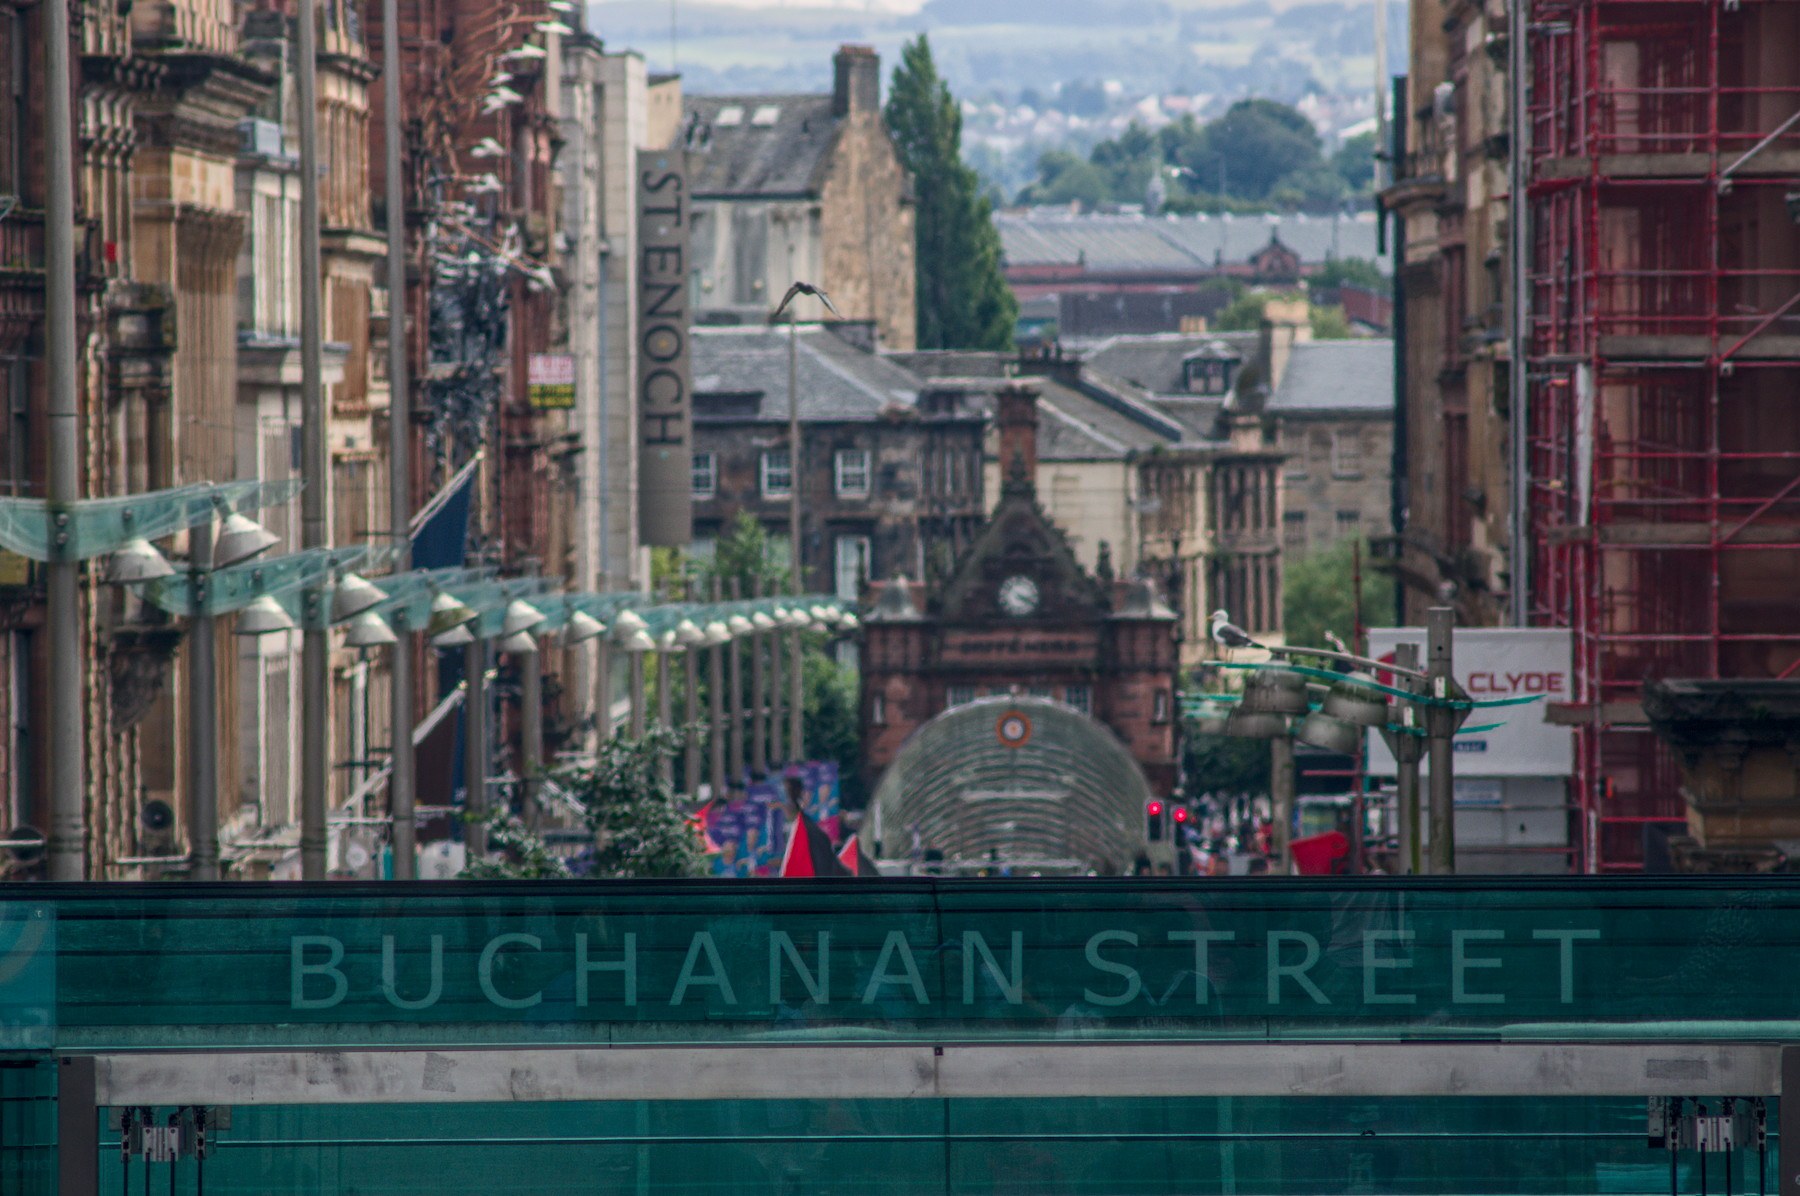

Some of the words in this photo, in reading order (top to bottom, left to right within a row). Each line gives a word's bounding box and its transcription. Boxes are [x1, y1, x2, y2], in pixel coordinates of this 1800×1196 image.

[642, 171, 683, 228] ST
[643, 246, 684, 446] ENOCH
[1468, 672, 1565, 693] CLYDE
[290, 930, 1024, 1010] BUCHANAN
[1083, 929, 1601, 1007] STREET
